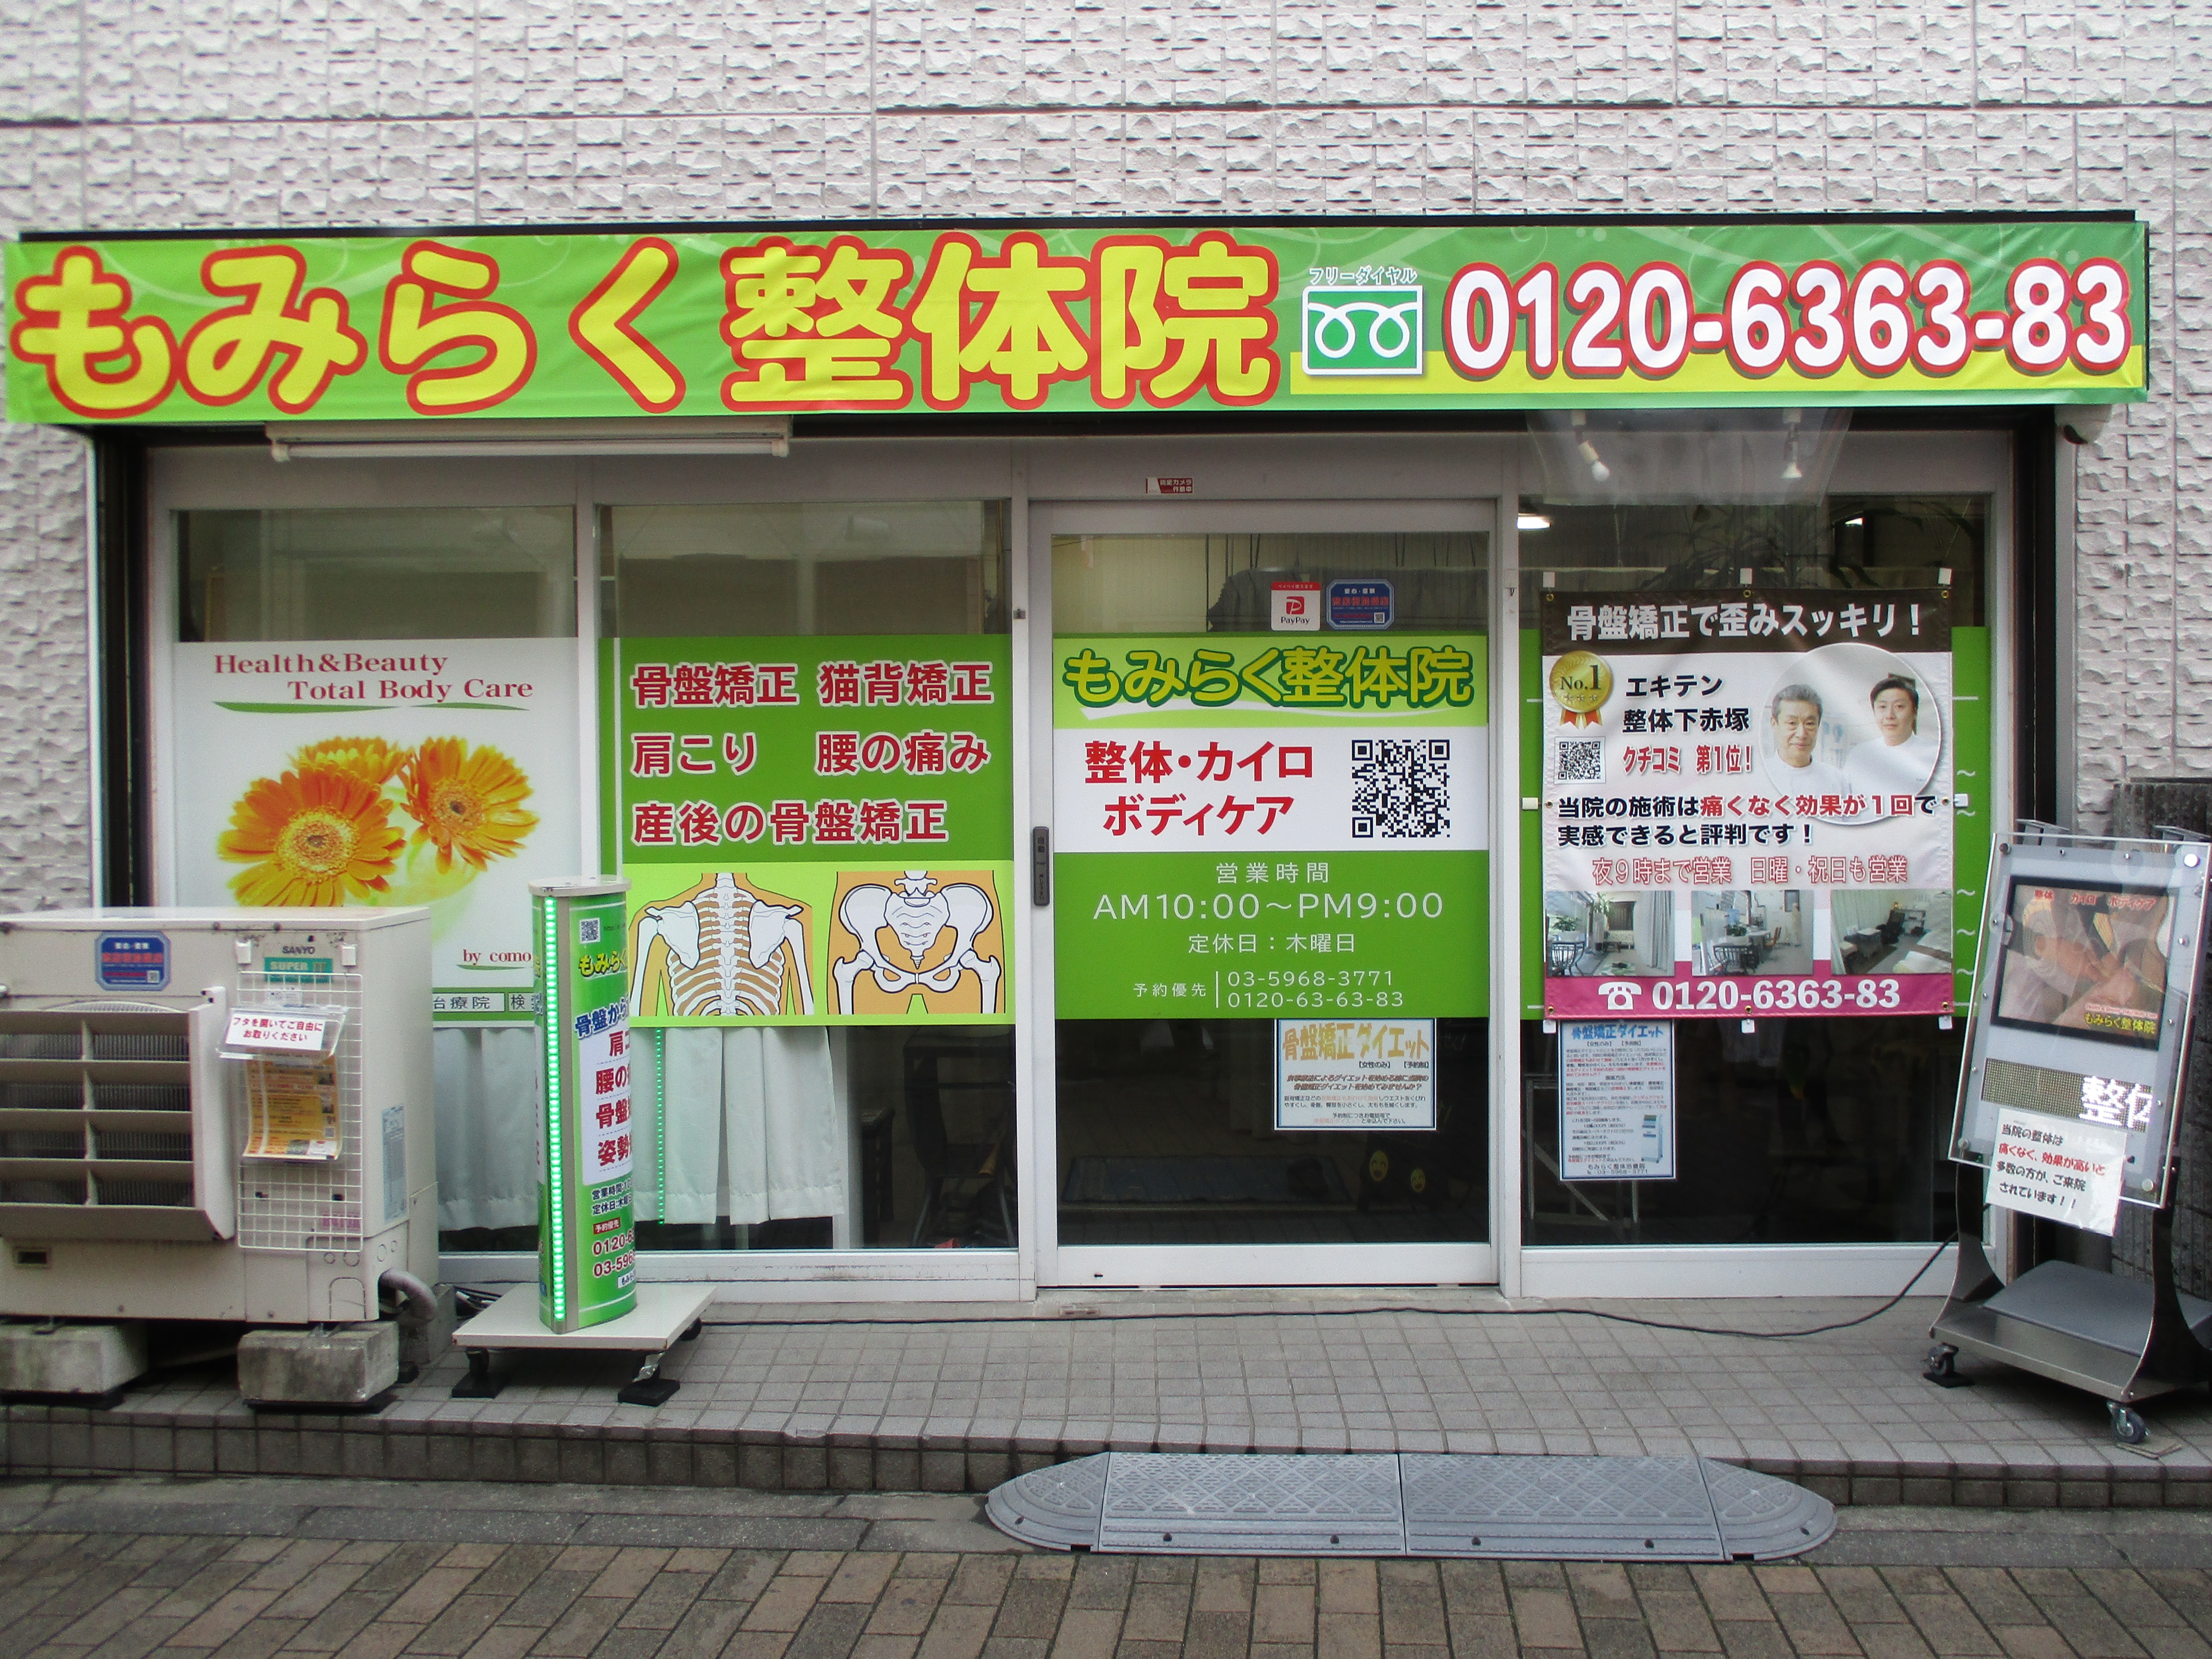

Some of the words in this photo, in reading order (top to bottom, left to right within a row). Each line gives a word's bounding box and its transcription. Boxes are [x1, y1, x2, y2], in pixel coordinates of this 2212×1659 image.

[1309, 264, 1418, 286] フリーダイヤル
[10, 231, 1282, 419] もみらく整体院
[1444, 258, 2131, 379] 0120-6363-83
[1281, 616, 1310, 626] PayPay
[1567, 602, 1921, 642] 骨盤矯正で歪みスッキリ！
[215, 653, 448, 676] Health&Beauty
[1063, 645, 1473, 708] もみらく整体院
[1560, 664, 1601, 690] No.1
[288, 681, 366, 701] Total
[380, 680, 452, 702] Body
[464, 678, 533, 698] Care
[631, 662, 800, 708] 骨盤矯正
[815, 660, 994, 707] 猫背矯正
[1626, 675, 1723, 699] エキテン
[1623, 708, 1750, 734] 整体下赤塚
[629, 731, 757, 777] 肩こり
[814, 729, 991, 775] 腰の痛み
[1085, 740, 1313, 784] 整体・カイロ
[1623, 744, 1681, 775] クチコミ
[1103, 794, 1294, 836] ボディケア
[1558, 793, 1937, 820] 当院の施術は痛くなく効果が1回で
[631, 799, 949, 847] 産後の骨盤矯正
[1557, 823, 1813, 848] 実感できると評判です！
[1215, 862, 1329, 884] 営業時間
[1592, 857, 1733, 886] 夜9時まで営業
[1750, 855, 1908, 884] 日曜・祝日も営業
[1093, 893, 1443, 920] AM10:00～PM9:00
[282, 945, 315, 954] SANYO
[462, 949, 481, 966] by
[489, 951, 532, 962] como
[1133, 982, 1207, 997] 予約優先
[1228, 971, 1394, 987] 03-5968-3771
[510, 994, 535, 1009] 検
[1228, 992, 1404, 1008] 0120-63-63-83
[1652, 978, 1900, 1011] 0120-6363-83
[243, 1030, 307, 1042] お取りください
[1282, 1022, 1430, 1061] 骨盤矯正ダイエット
[596, 1065, 631, 1094] 腰の
[596, 1096, 631, 1129] 骨盤
[2001, 1123, 2063, 1146] 当院の整体は
[598, 1133, 632, 1167] 姿勢
[593, 1249, 635, 1278] 03-596
